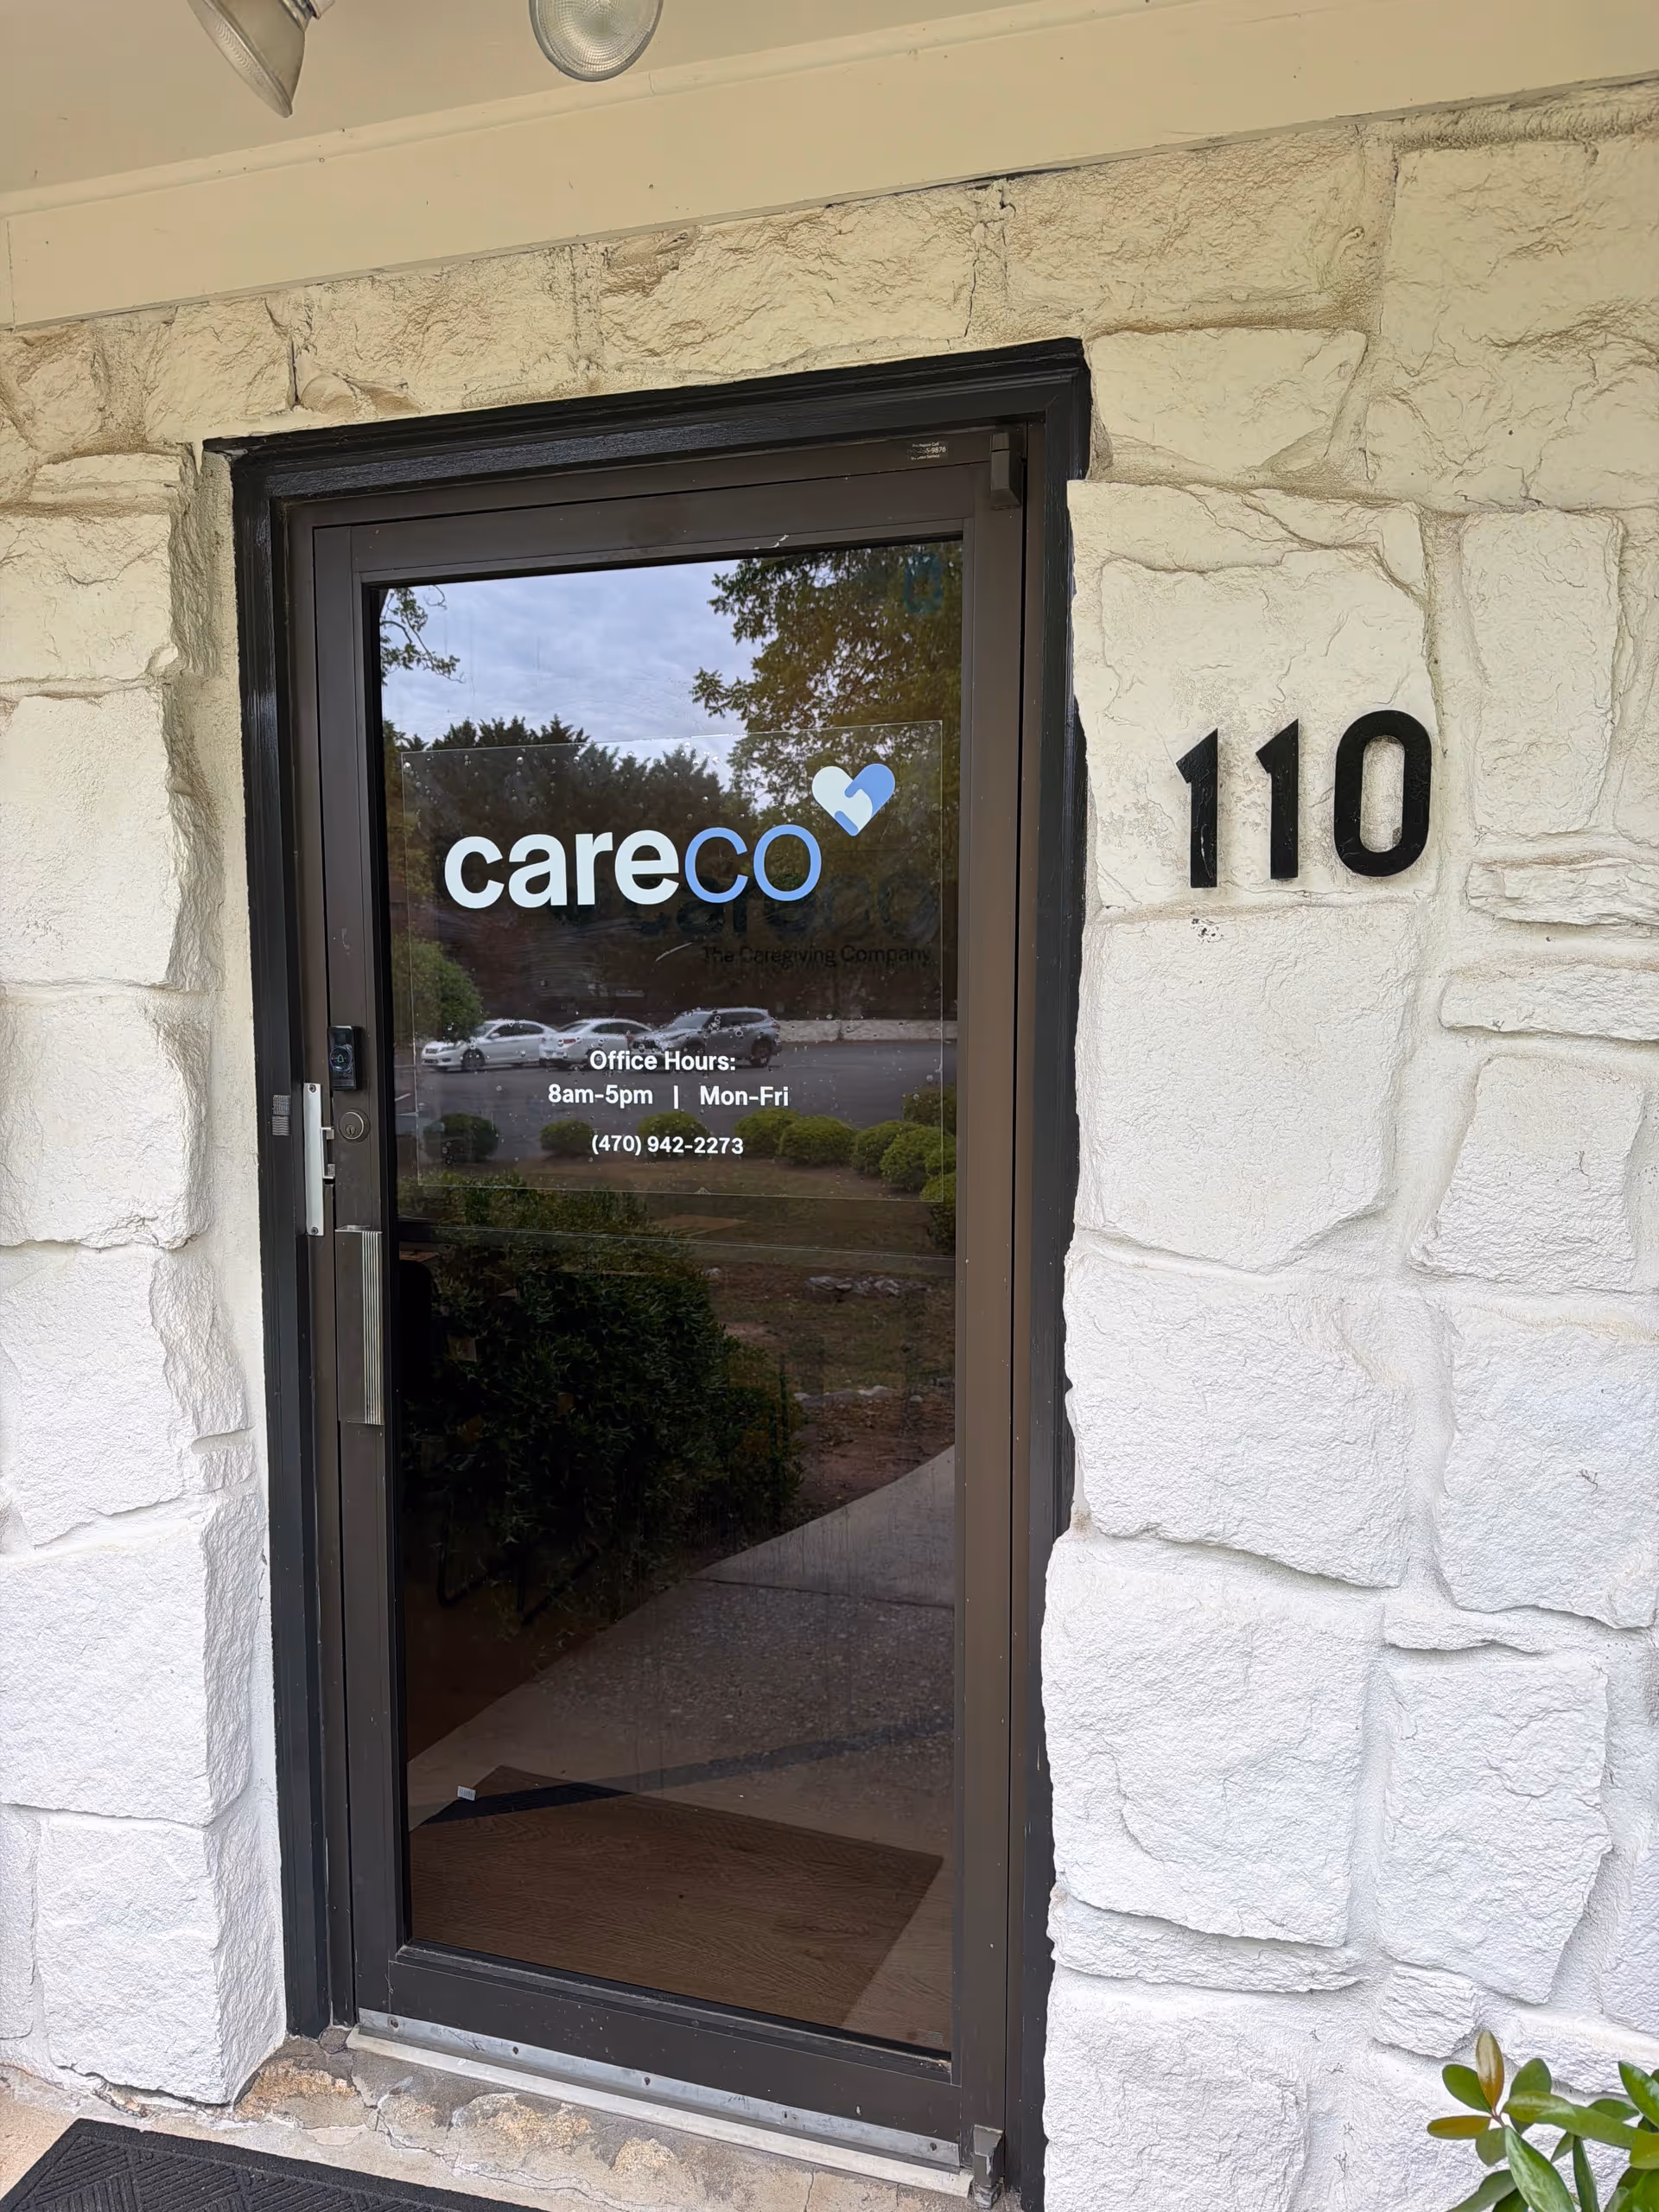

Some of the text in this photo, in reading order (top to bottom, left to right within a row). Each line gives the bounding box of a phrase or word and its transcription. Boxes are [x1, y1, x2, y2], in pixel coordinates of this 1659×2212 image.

[1176, 709, 1432, 888] 110
[444, 824, 823, 909] careco
[704, 944, 931, 969] The Caregiving Company
[589, 1050, 736, 1071] Office Hours:
[548, 1084, 653, 1109] 8am-5pm
[700, 1085, 789, 1107] Mon-Fri
[592, 1135, 744, 1156] (470) 942-2273
